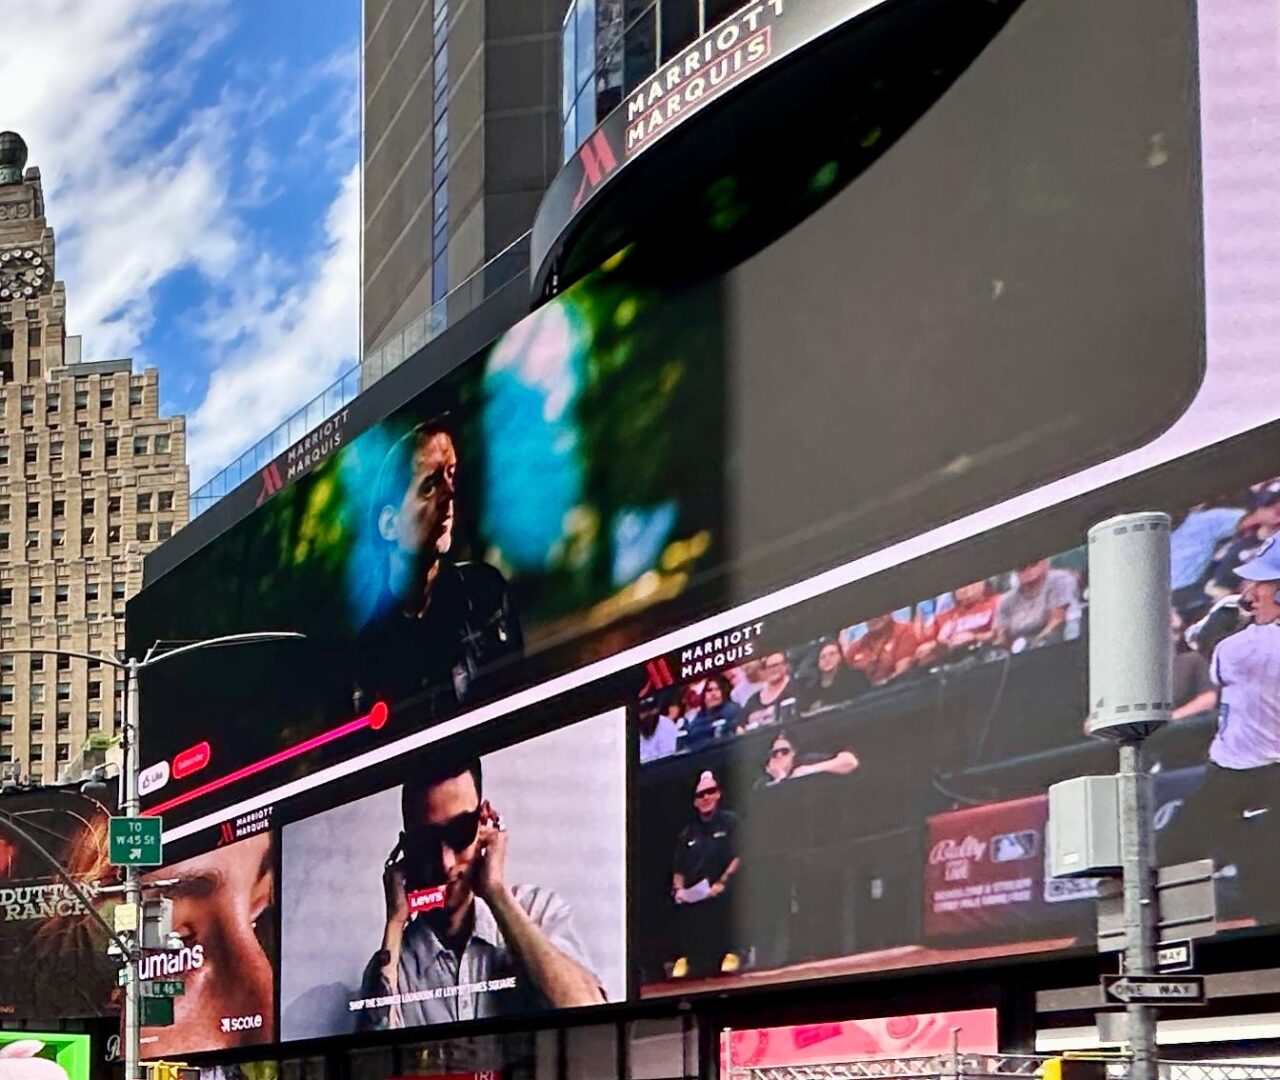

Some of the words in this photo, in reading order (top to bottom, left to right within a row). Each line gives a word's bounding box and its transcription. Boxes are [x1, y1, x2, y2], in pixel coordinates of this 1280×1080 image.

[628, 0, 784, 120] MARRIOTT
[628, 36, 767, 149] MARQUIS
[288, 409, 349, 463] MARRIOTT
[287, 433, 341, 480] MARQUIS
[681, 622, 764, 663] MARRIOTT
[681, 643, 754, 678] MARQUIS
[128, 822, 143, 832] TO
[236, 806, 274, 827] MARRIOTT
[236, 820, 270, 837] MARQUIS
[116, 835, 126, 844] W
[127, 834, 141, 845] 45
[144, 834, 155, 844] St
[0, 886, 96, 907] DUTTON
[411, 893, 444, 908] LeVI'S
[4, 902, 92, 922] RANCH
[139, 944, 205, 980] umans
[488, 976, 517, 991] SQUARE
[1114, 984, 1143, 995] ONE
[1159, 984, 1191, 995] WAY
